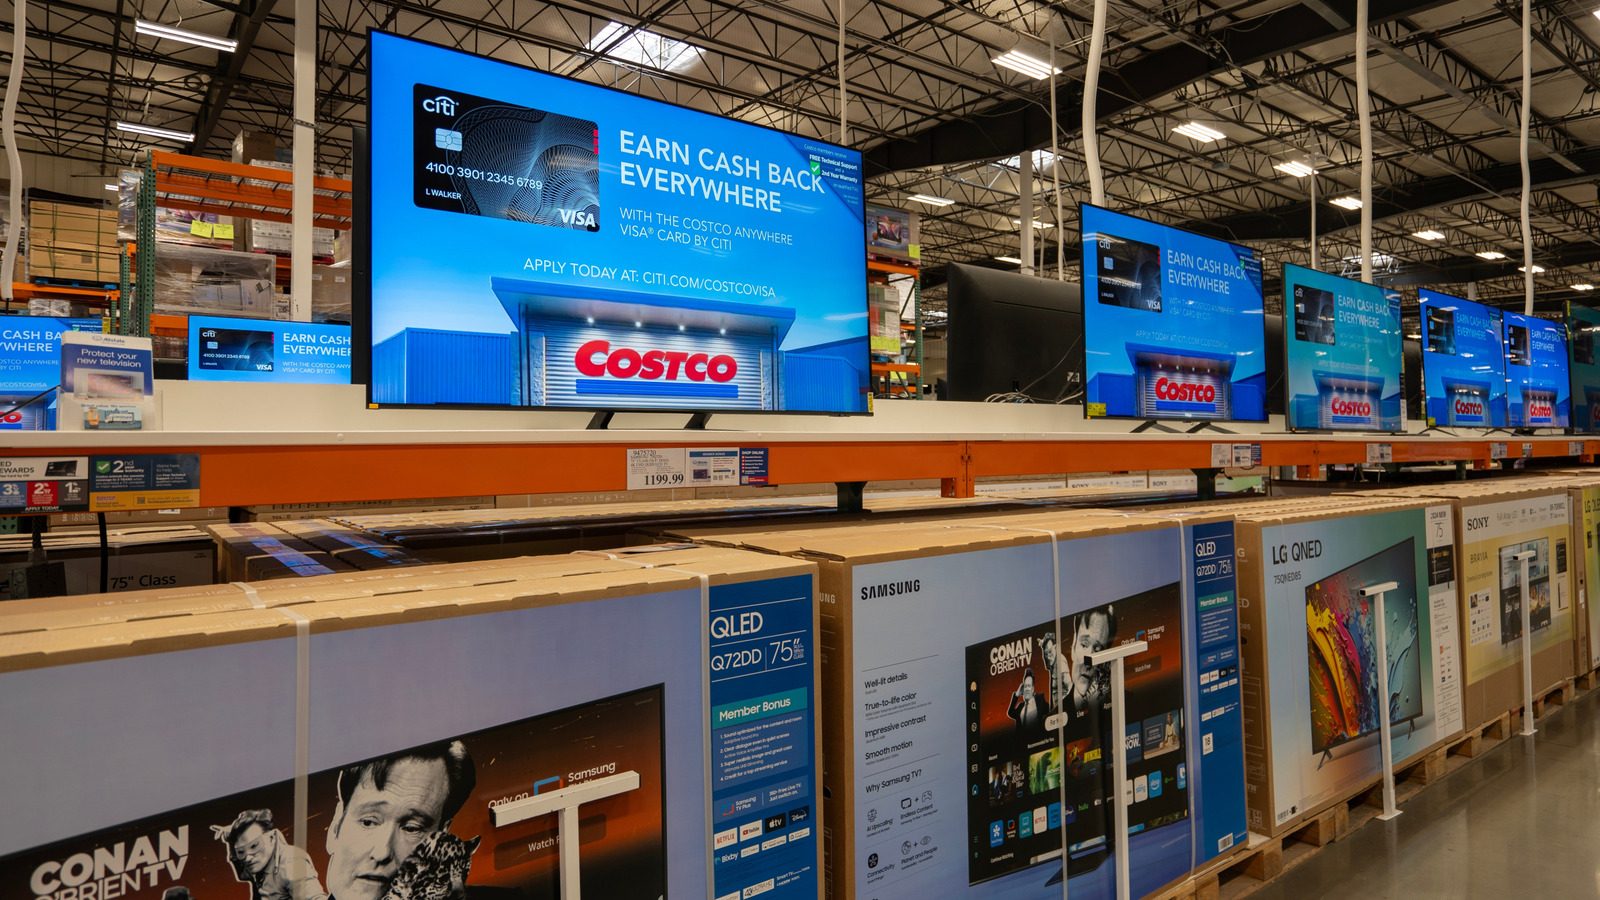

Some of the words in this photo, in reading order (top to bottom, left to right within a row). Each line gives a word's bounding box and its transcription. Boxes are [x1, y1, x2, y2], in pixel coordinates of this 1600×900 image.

[423, 96, 457, 117] citi
[620, 130, 689, 166] EARN
[698, 148, 760, 180] CASH
[768, 163, 825, 194] BACK
[822, 157, 840, 166] Technical
[841, 162, 858, 170] Support
[426, 162, 454, 176] 4100
[457, 166, 485, 181] 3901
[487, 171, 514, 186] 2345
[516, 176, 543, 190] 6789
[840, 174, 858, 184] Warranty
[426, 188, 430, 196] L
[431, 189, 462, 200] WALKER
[620, 161, 782, 213] EVERYWHERE
[558, 209, 596, 228] VISA
[620, 207, 652, 223] WITH
[656, 212, 679, 228] THE
[682, 217, 732, 236] COSTCO
[734, 226, 793, 246] ANYWHERE
[657, 230, 691, 245] CARD
[694, 235, 710, 247] BY
[712, 237, 732, 250] CITI
[1168, 249, 1194, 269] EARN
[1196, 256, 1222, 276] CASH
[1224, 263, 1247, 281] BACK
[523, 258, 567, 275] APPLY
[570, 263, 618, 280] TODAY
[620, 269, 639, 283] AT:
[643, 271, 776, 298] CITI.COM/COSTCOVISA
[1168, 269, 1230, 295] EVERYWHERE
[1147, 300, 1162, 310] VISA
[1338, 295, 1356, 309] EARN
[1357, 299, 1374, 313] CASH
[1375, 303, 1391, 317] BACK
[1338, 310, 1380, 329] EVERYWHERE
[1456, 312, 1469, 325] EARN
[1470, 316, 1481, 327] CASH
[3, 330, 40, 340] CASH
[202, 330, 216, 338] citi
[284, 332, 316, 344] EARN
[320, 334, 351, 346] CASH
[1136, 330, 1151, 340] APPLY
[1152, 332, 1170, 342] TODAY
[1458, 326, 1487, 341] EVERYWHERE
[1532, 330, 1541, 339] EARN
[82, 348, 114, 358] Protect
[1532, 340, 1555, 352] EVERYWHERE
[100, 358, 142, 368] television
[574, 339, 738, 383] COSTCO
[1155, 377, 1216, 403] COSTCO
[1332, 397, 1371, 416] COSTCO
[1455, 399, 1482, 416] COSTCO
[1530, 404, 1552, 417] COSTCO
[645, 474, 684, 486] 1199.99
[1467, 516, 1490, 531] SONY
[1196, 541, 1216, 558] QLED
[1272, 544, 1288, 565] LG
[1292, 540, 1322, 562] QNED
[1470, 552, 1488, 564] BRAVIA
[1196, 564, 1216, 577] Q72DD
[1274, 571, 1302, 585] 75QNED85
[111, 576, 134, 590] 75"
[139, 574, 176, 588] Class
[861, 579, 921, 601] SAMSUNG
[1200, 598, 1216, 608] Member
[710, 611, 764, 640] QLED
[1148, 625, 1165, 636] Samsung
[990, 636, 1033, 664] CONAN
[711, 648, 763, 672] Q72DD
[864, 676, 886, 689] Well-lit
[887, 672, 908, 684] details
[719, 704, 761, 722] Member
[762, 698, 791, 712] Bonus
[864, 696, 900, 712] True-to-life
[901, 692, 917, 702] color
[865, 724, 900, 738] Impressive
[900, 714, 926, 728] contrast
[865, 746, 891, 760] Smooth
[891, 740, 913, 754] motion
[568, 762, 616, 782] Samsung
[866, 782, 880, 794] Why
[882, 774, 911, 788] Samsung
[911, 768, 922, 778] TV?
[736, 796, 756, 806] Samsung
[900, 810, 916, 820] Endless
[916, 804, 934, 814] Content
[748, 826, 760, 834] YouTube
[528, 837, 554, 852] Watch
[716, 833, 735, 845] NETFLIX
[30, 824, 190, 896] CONAN
[722, 852, 738, 863] Bixby
[901, 855, 914, 864] Planet
[924, 846, 938, 856] People
[143, 855, 189, 888] TV
[868, 864, 896, 878] Connectivity
